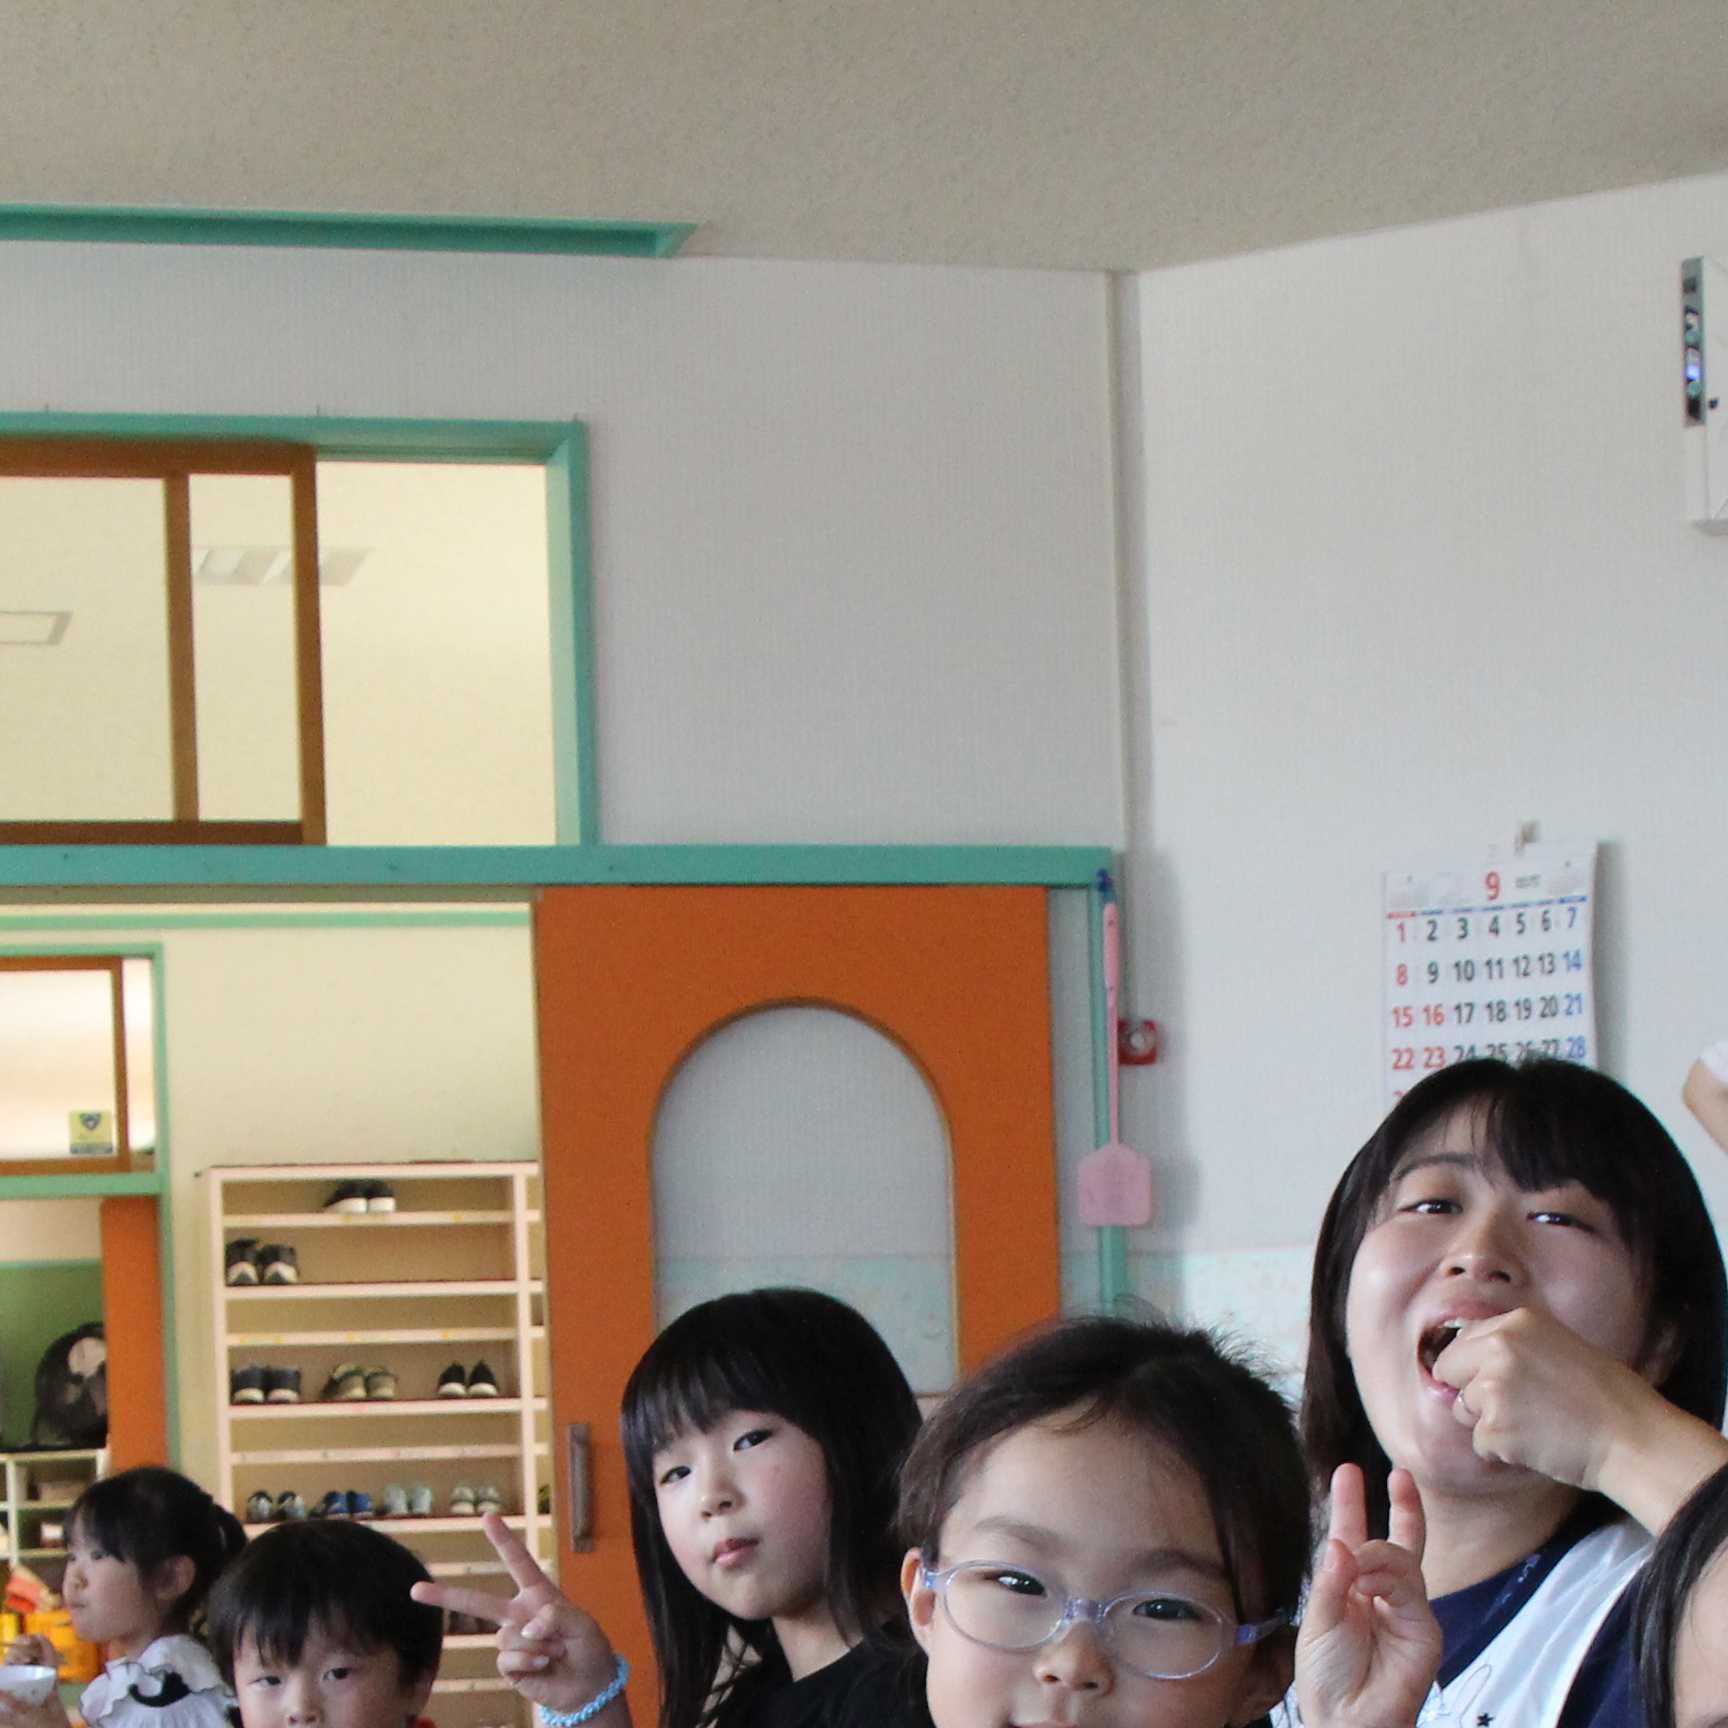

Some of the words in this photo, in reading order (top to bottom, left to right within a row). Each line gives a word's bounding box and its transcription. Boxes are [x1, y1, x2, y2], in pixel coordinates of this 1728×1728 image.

[1485, 871, 1501, 901] 9
[1396, 921, 1407, 943] 1
[1426, 918, 1439, 942] 2
[1456, 916, 1469, 940] 3
[1488, 914, 1501, 938] 4
[1515, 912, 1527, 935] 5
[1541, 908, 1552, 932] 6
[1567, 905, 1578, 929] 7
[1396, 963, 1409, 986] 8
[1427, 961, 1439, 985] 9
[1454, 959, 1476, 982] 10
[1485, 957, 1505, 980] 11
[1513, 953, 1531, 977] 12
[1537, 952, 1556, 976] 13
[1563, 948, 1583, 972] 14
[1392, 1006, 1414, 1028] 15
[1423, 1003, 1446, 1026] 16
[1454, 1001, 1476, 1025] 17
[1487, 1000, 1508, 1023] 18
[1515, 997, 1533, 1020] 19
[1539, 994, 1559, 1019] 20
[1565, 992, 1584, 1016] 21
[1392, 1047, 1415, 1070] 22
[1423, 1046, 1446, 1070] 23
[1567, 1035, 1587, 1060] 28
